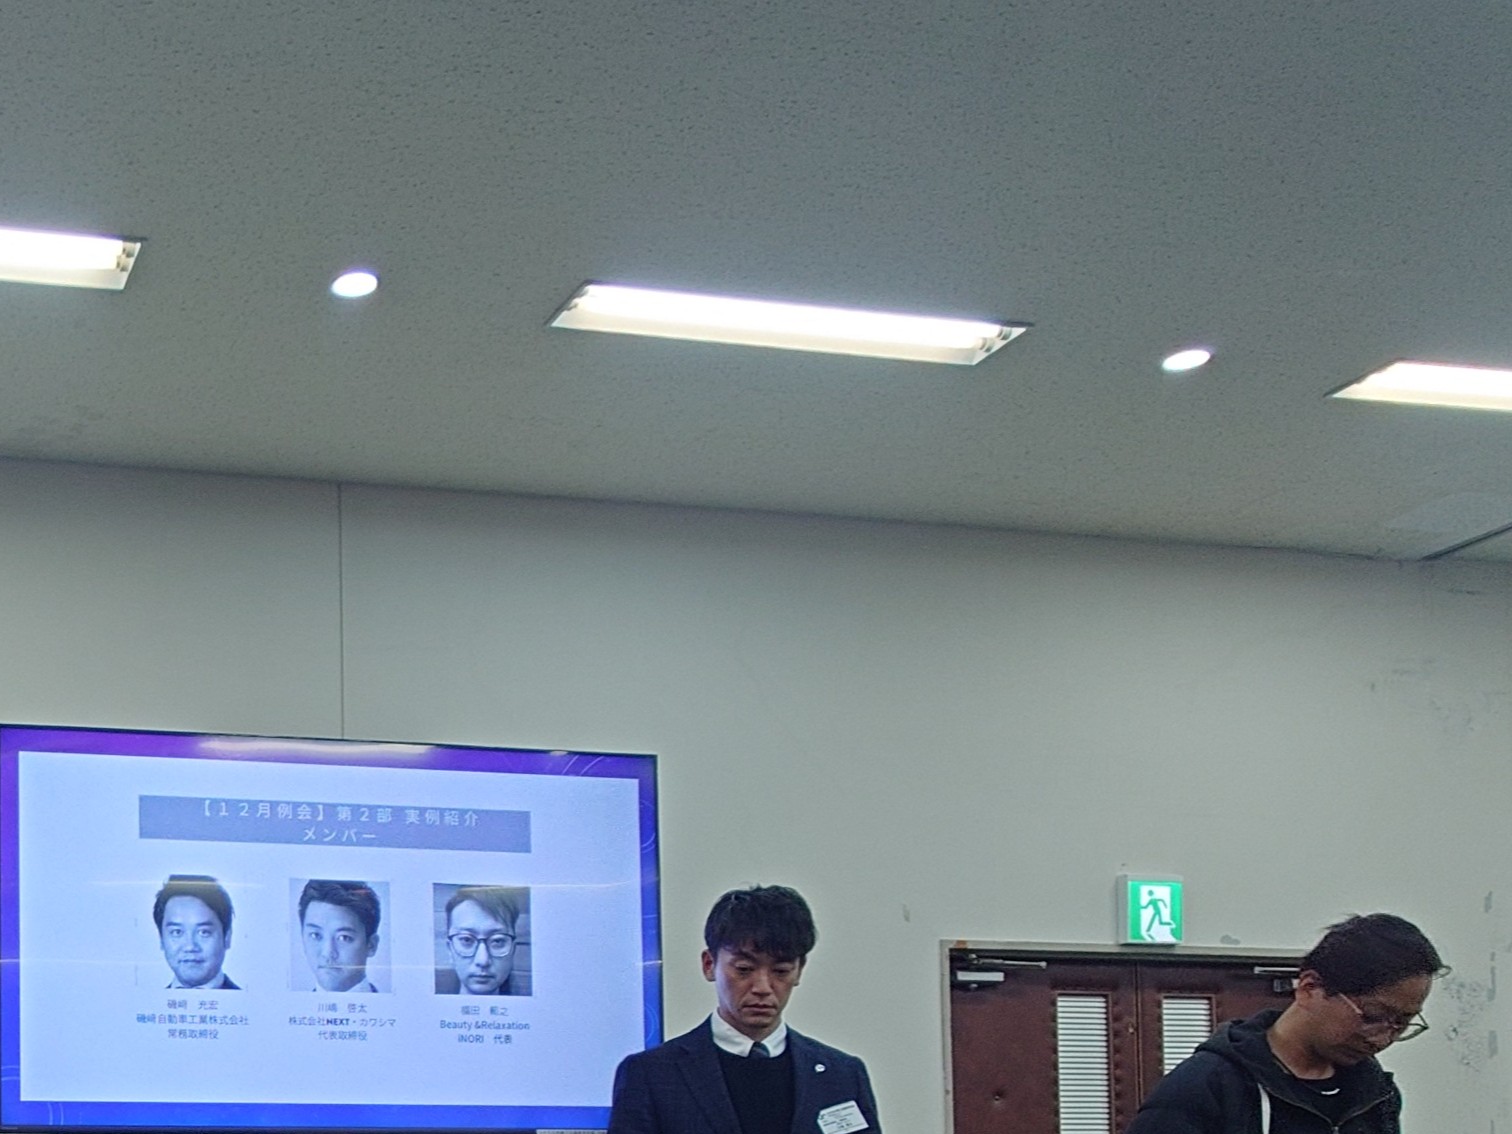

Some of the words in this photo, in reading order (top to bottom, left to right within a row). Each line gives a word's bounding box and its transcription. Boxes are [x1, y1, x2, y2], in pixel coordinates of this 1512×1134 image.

[405, 808, 478, 827] 実例紹介
[303, 826, 376, 843] メンバー
[440, 1020, 473, 1032] Beauty
[318, 1030, 368, 1041] 代表取締役
